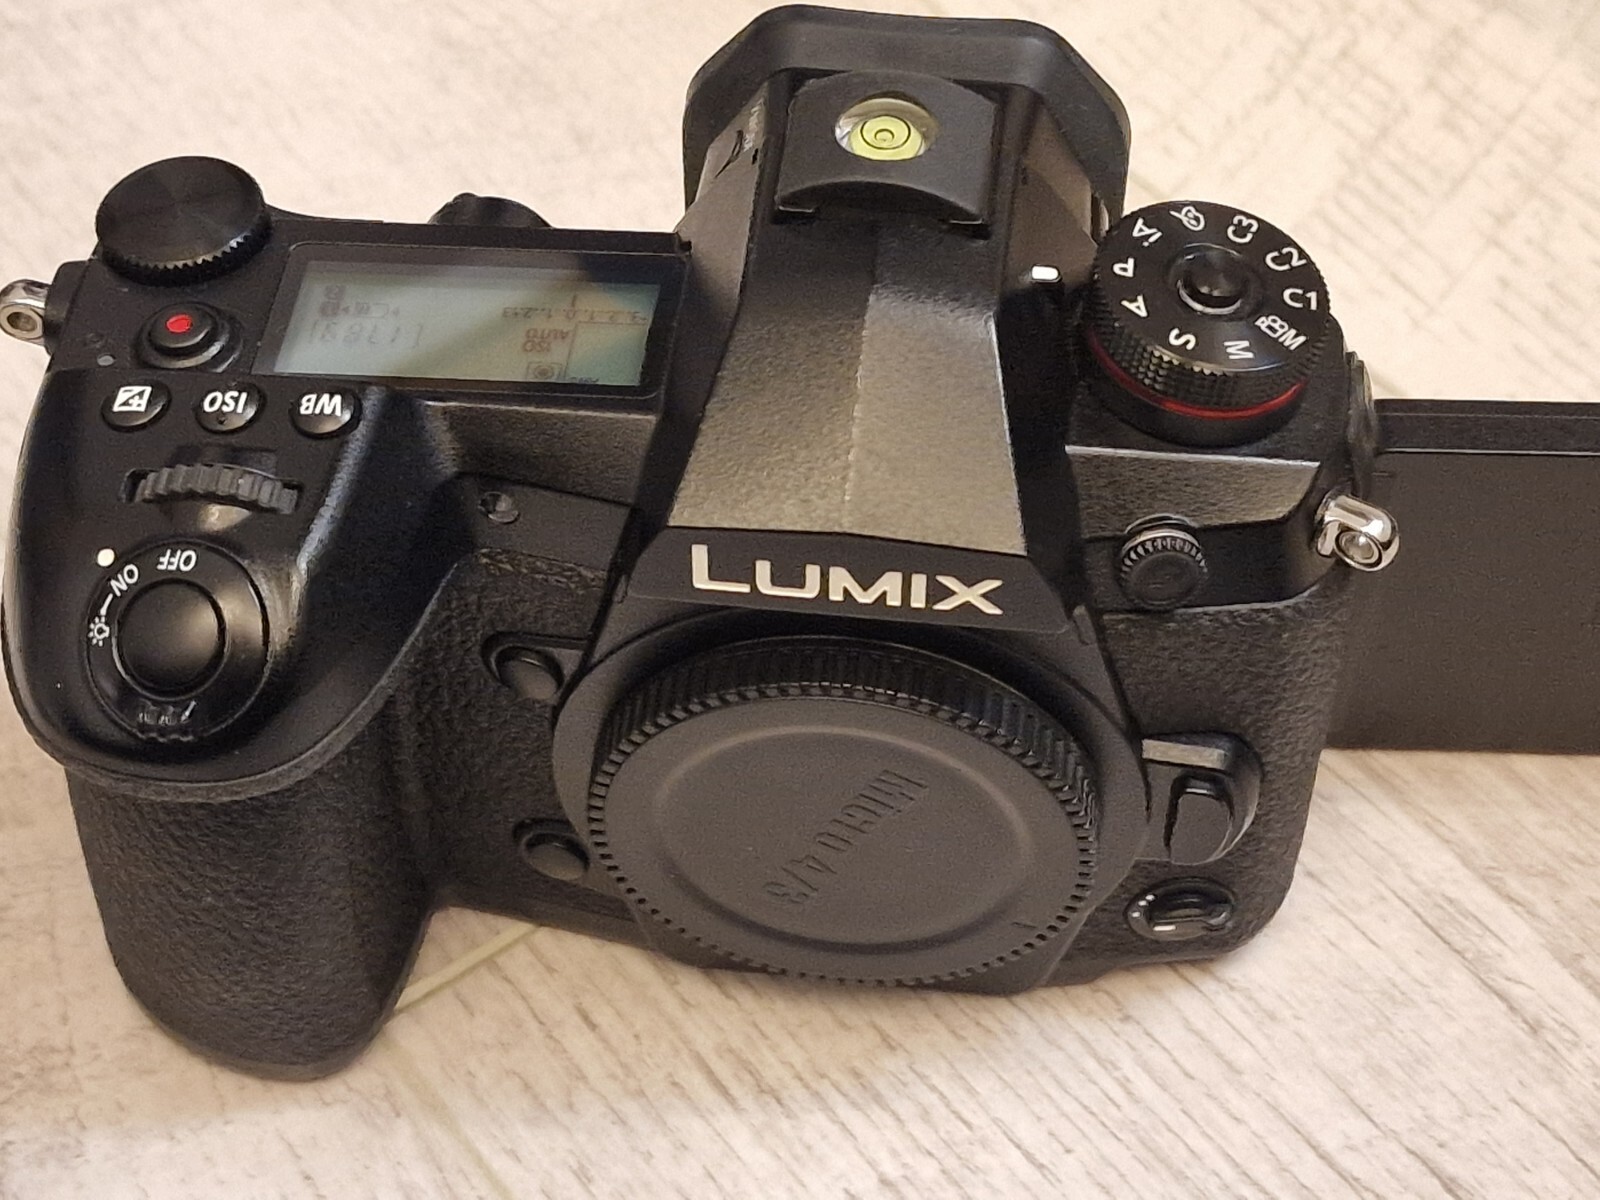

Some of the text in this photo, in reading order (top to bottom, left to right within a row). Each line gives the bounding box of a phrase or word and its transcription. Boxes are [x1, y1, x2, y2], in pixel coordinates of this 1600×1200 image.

[1227, 215, 1259, 243] C3
[1112, 257, 1135, 278] P
[1265, 246, 1307, 271] C2
[1121, 294, 1148, 318] A
[1283, 288, 1318, 310] C1
[1168, 328, 1197, 350] S
[1223, 340, 1255, 360] M
[203, 391, 247, 414] ISO
[300, 393, 343, 416] WB
[157, 549, 197, 572] OFF
[110, 564, 139, 596] ON
[691, 544, 1003, 615] LUMIX
